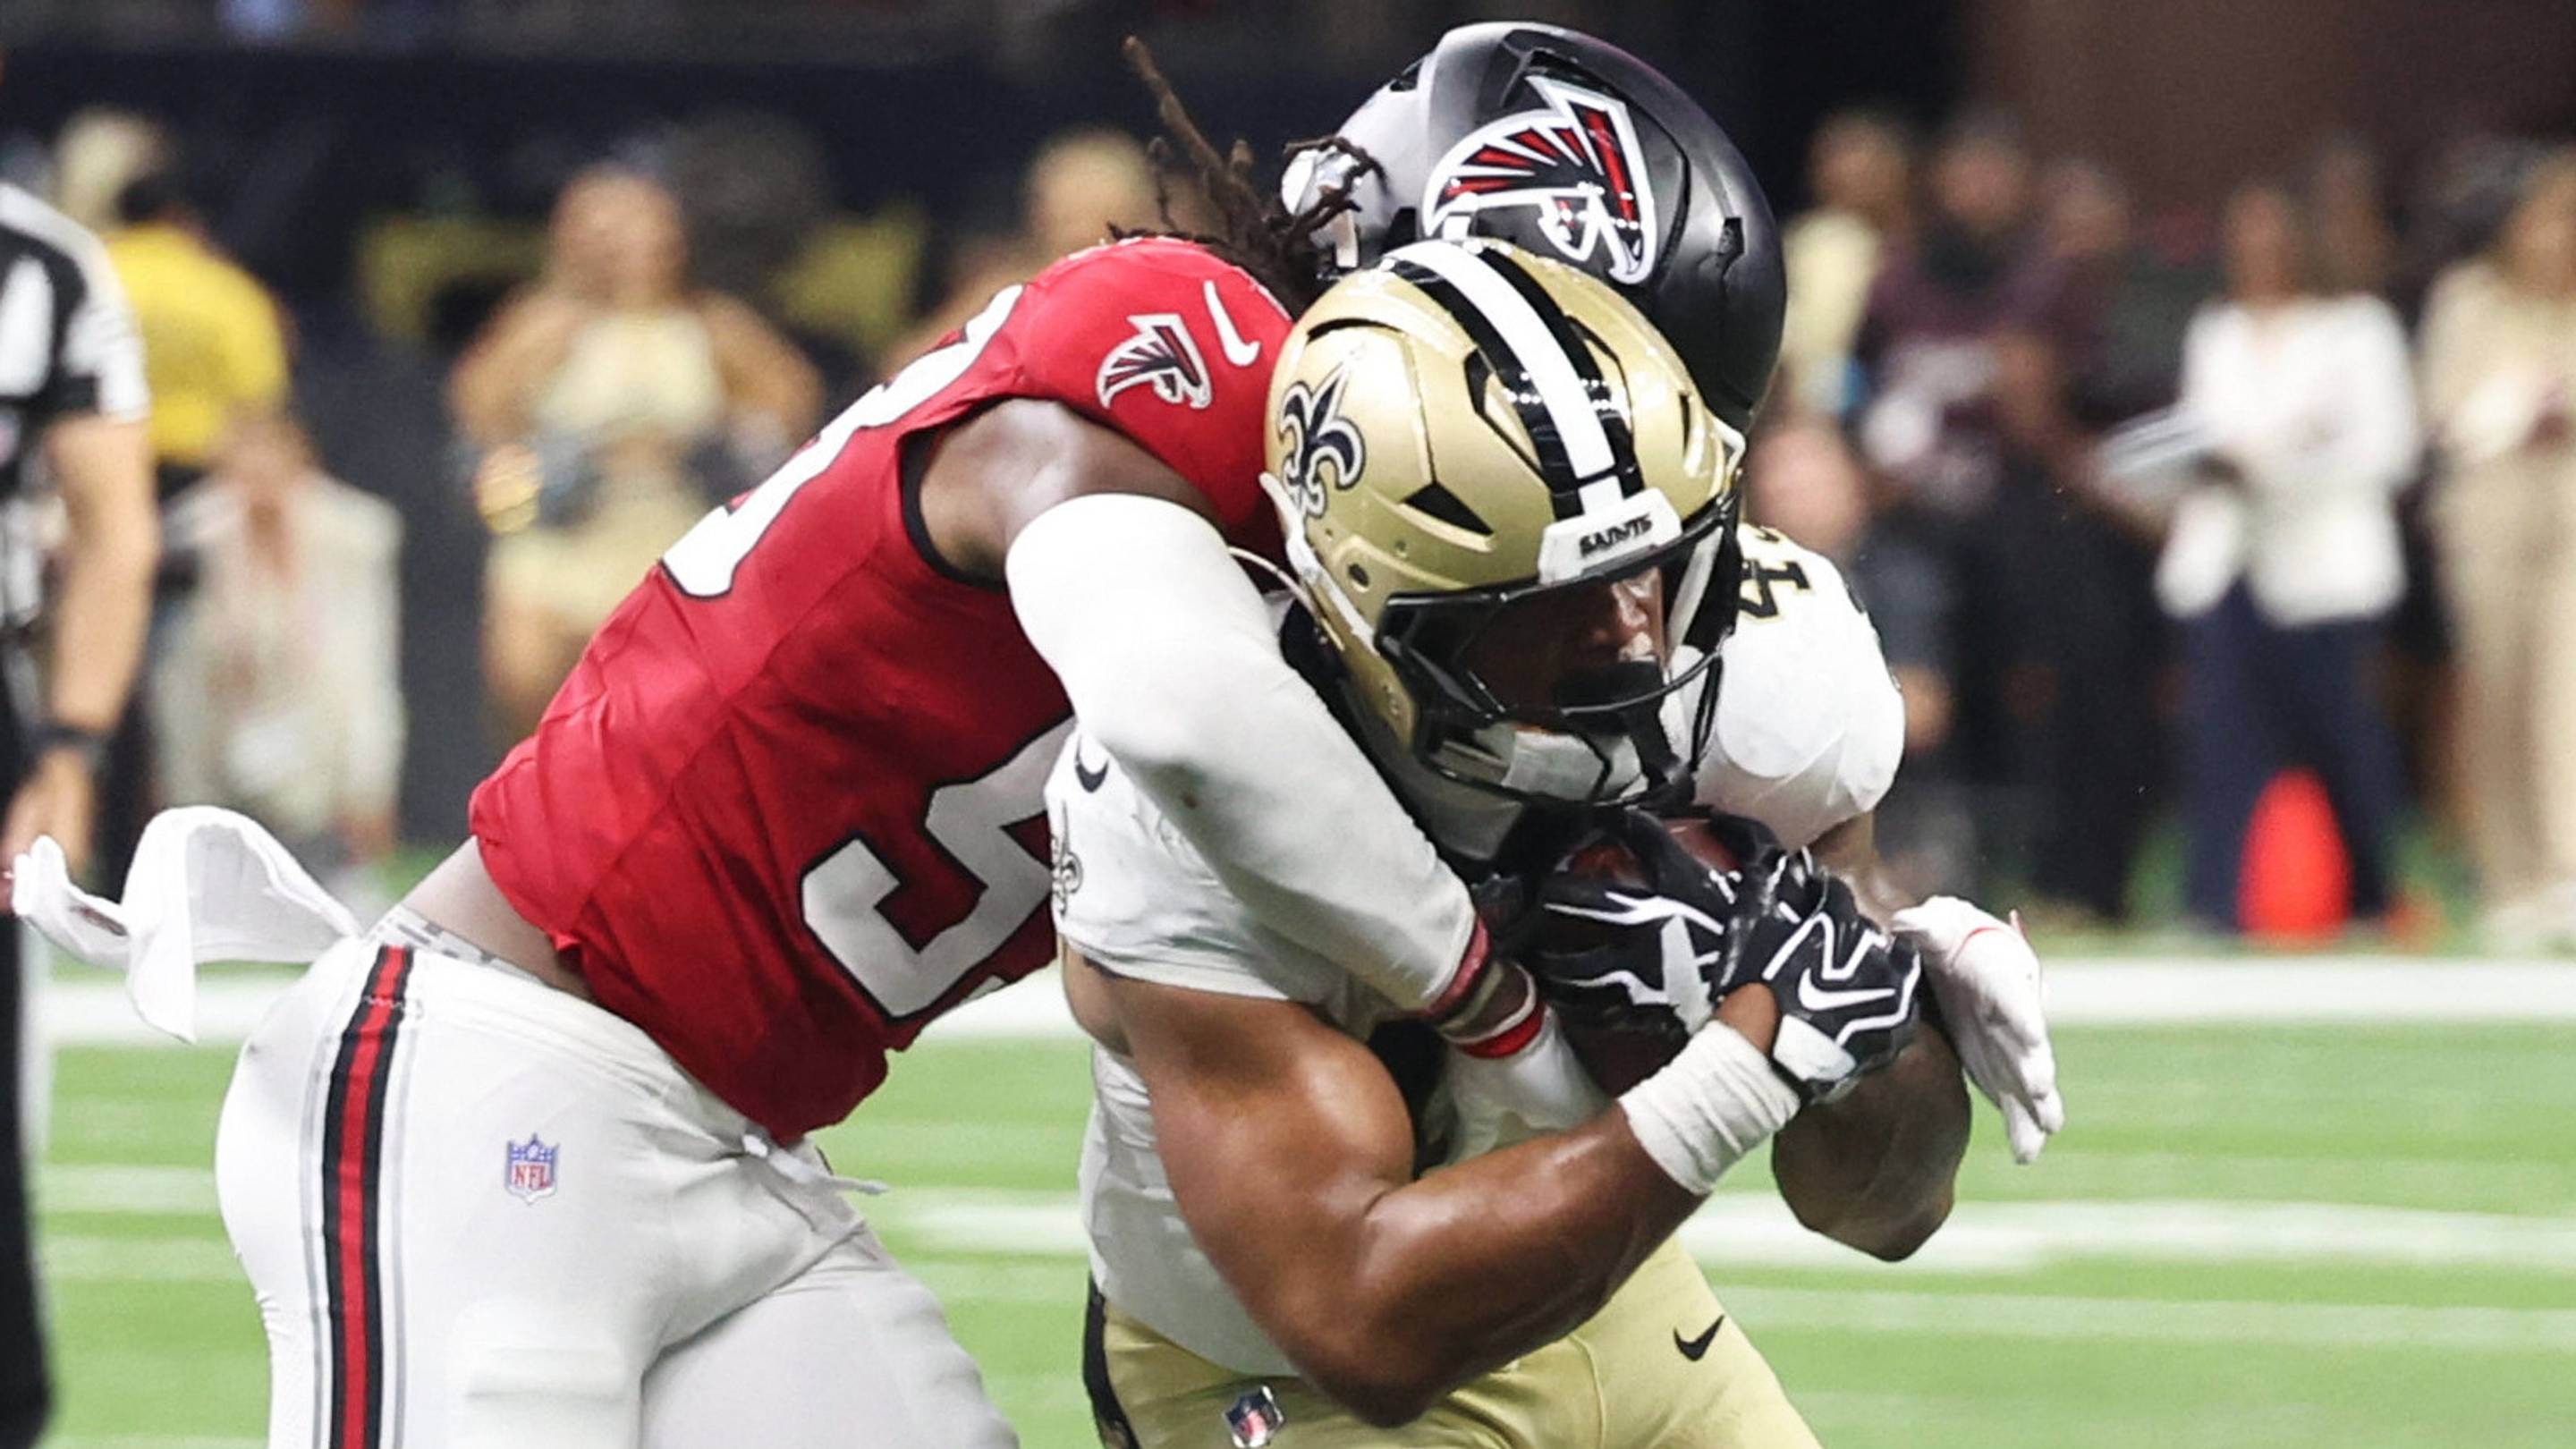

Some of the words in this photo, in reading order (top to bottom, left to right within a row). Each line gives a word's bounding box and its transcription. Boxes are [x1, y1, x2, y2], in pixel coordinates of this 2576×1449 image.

[1580, 514, 1653, 555] SAINTS
[1738, 526, 1811, 617] 4
[514, 1165, 552, 1189] NFL
